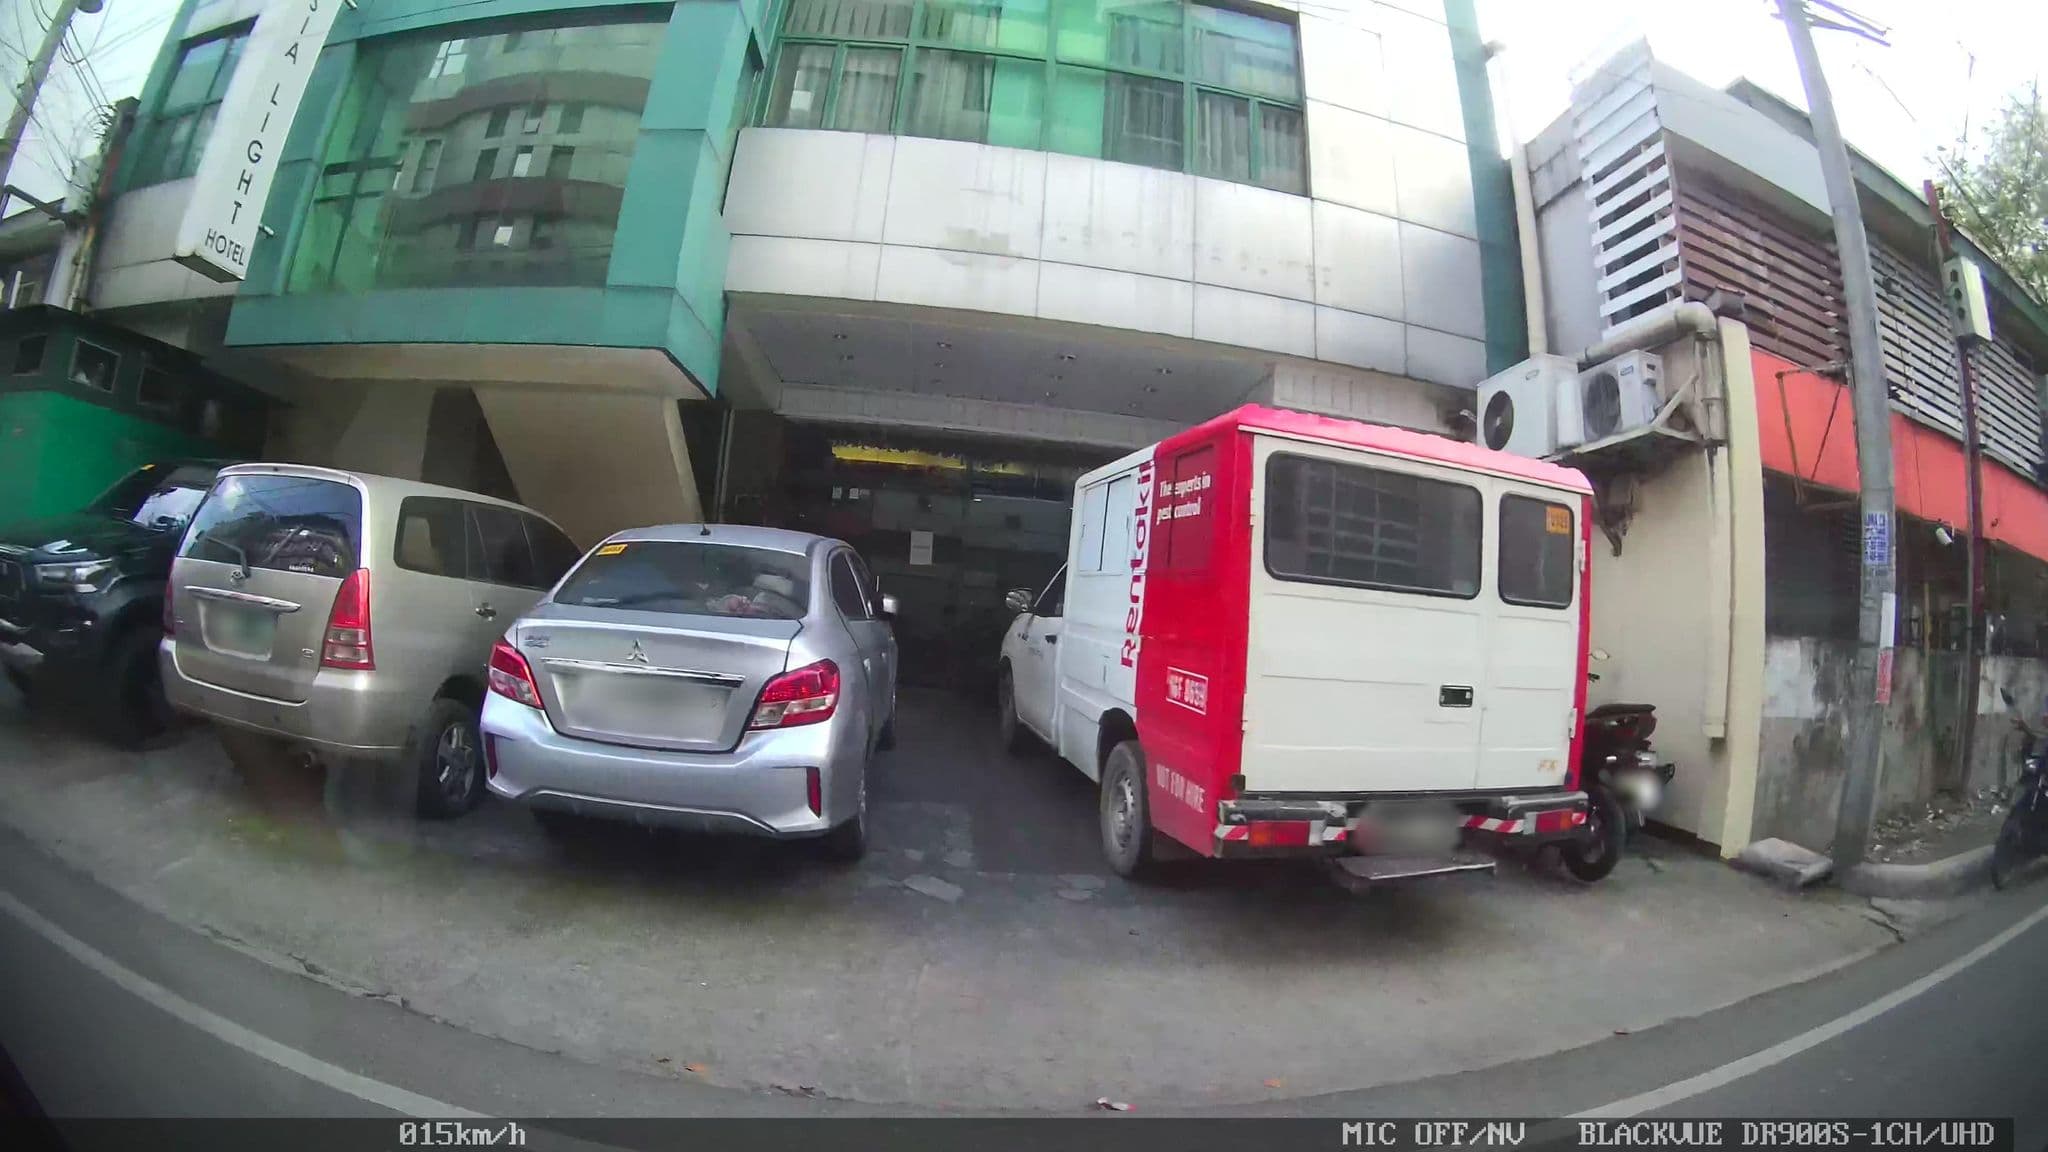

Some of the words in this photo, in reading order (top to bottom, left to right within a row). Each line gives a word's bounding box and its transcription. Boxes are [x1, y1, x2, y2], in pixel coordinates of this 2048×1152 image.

[230, 82, 281, 225] LIGHT
[204, 227, 245, 267] HOTEL
[1121, 460, 1154, 668] Rentokil
